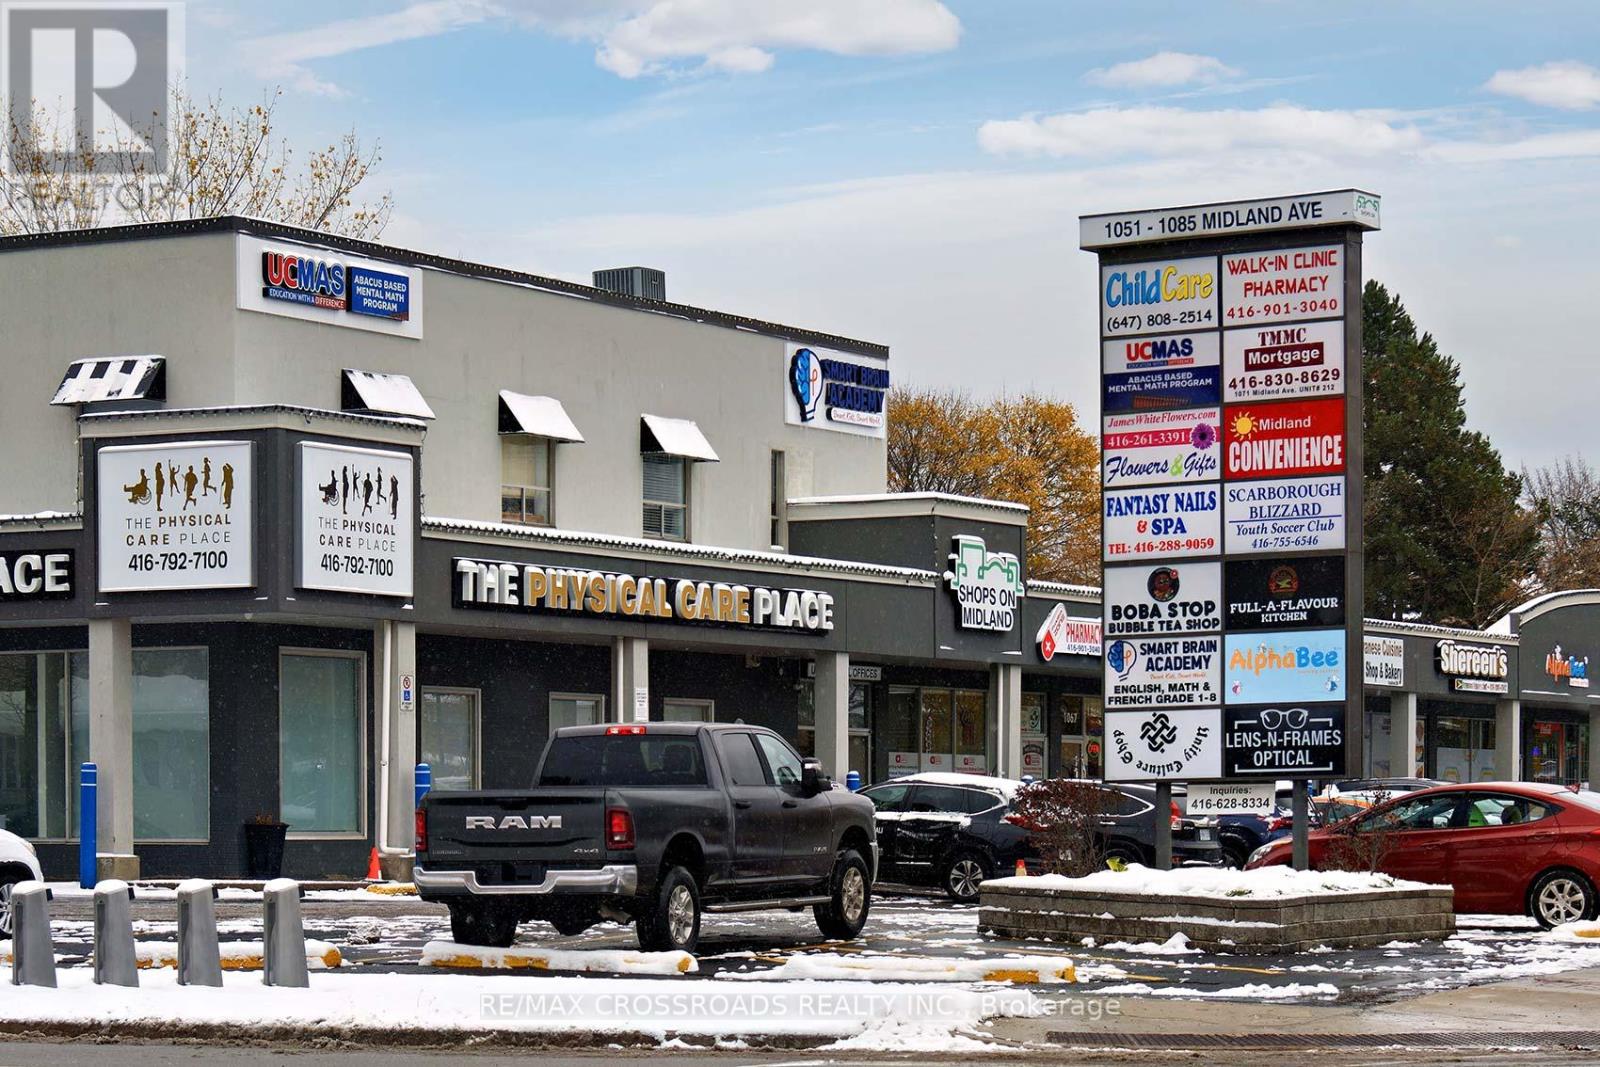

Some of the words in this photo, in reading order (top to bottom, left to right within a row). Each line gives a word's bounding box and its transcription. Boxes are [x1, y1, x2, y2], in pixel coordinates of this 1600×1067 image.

[1104, 221, 1141, 238] 1051
[1159, 215, 1196, 234] 1085
[1202, 206, 1282, 230] MIDLAND
[1288, 201, 1322, 221] AVE
[1227, 254, 1288, 275] WALK-IN
[1294, 250, 1337, 269] CLINIC
[265, 251, 345, 296] UCMAS
[354, 275, 382, 288] ABACUS
[384, 280, 407, 292] BASED
[1106, 265, 1213, 308] ChildCare
[1244, 275, 1328, 298] PHARMACY
[356, 286, 384, 298] MENTAL
[385, 290, 405, 302] MATH
[363, 298, 398, 312] PROGRAM
[1227, 299, 1338, 319] 416-901-3040
[1107, 315, 1142, 332] (647)
[1147, 310, 1212, 327] 808-2514
[1258, 328, 1306, 346] TMMC
[1126, 338, 1193, 361] UCMAS
[1249, 349, 1320, 365] Mortgage
[822, 360, 859, 383] SMART
[860, 366, 889, 388] BRAIN
[1128, 374, 1162, 384] ABACUS
[1164, 372, 1193, 381] BASED
[1229, 368, 1340, 390] 416-830-8629
[1108, 383, 1142, 393] MENTAL
[1145, 380, 1168, 390] MATH
[1170, 378, 1212, 388] PROGRAM
[1252, 388, 1279, 396] Midland
[827, 383, 884, 413] ACADEMY
[1108, 411, 1216, 428] JamesWhiteFlowers.com
[1259, 416, 1311, 431] Midland
[1108, 431, 1185, 447] 416-261-3391
[1229, 435, 1342, 472] CONVENIENCE
[1106, 456, 1169, 483] Flowers
[1170, 455, 1183, 477] &
[1184, 452, 1217, 477] Gifts
[1228, 483, 1341, 502] SCARBOROUGH
[1106, 493, 1170, 517] FANTASY
[1174, 491, 1216, 513] NAILS
[1249, 503, 1322, 519] BLIZZARD
[126, 517, 152, 530] THE
[158, 514, 232, 527] PHYSICAL
[318, 516, 338, 530] THE
[342, 520, 396, 536] PHYSICAL
[1137, 520, 1147, 533] &
[1151, 518, 1187, 535] SPA
[1236, 523, 1267, 536] Youth
[1271, 521, 1304, 534] Soccer
[1307, 519, 1335, 531] Club
[126, 533, 170, 546] CARE
[179, 531, 231, 544] PLACE
[319, 534, 352, 548] CARE
[358, 538, 396, 552] PLACE
[1108, 543, 1131, 554] TEL:
[1134, 538, 1214, 553] 416-288-9059
[1252, 536, 1318, 549] 416-755-6546
[128, 550, 228, 572] 416-792-7100
[320, 552, 394, 577] 416-792-7100
[457, 559, 519, 605] THE
[524, 566, 672, 618] PHYSICAL
[676, 579, 750, 624] CARE
[753, 587, 834, 631] PLACE
[959, 585, 996, 605] SHOPS
[999, 588, 1016, 608] ON
[1111, 603, 1162, 620] BOBA
[1167, 600, 1216, 618] STOP
[1230, 597, 1338, 614] FULL-A-FLAVOUR
[963, 607, 1013, 629] MIDLAND
[1108, 620, 1154, 634] BUBBLE
[1158, 620, 1182, 631] TEA
[1186, 618, 1220, 630] SHOP
[1261, 612, 1307, 623] KITCHEN
[1066, 623, 1102, 645] PHARMAC
[1140, 642, 1179, 655] SMART
[1182, 640, 1217, 654] BRAIN
[1146, 655, 1211, 672] ACADEMY
[1229, 647, 1339, 676] AlphaBee
[1441, 641, 1508, 677] Shereen's
[852, 668, 878, 678] OFFICES
[1114, 683, 1164, 695] ENGLISH,
[1168, 683, 1199, 693] MATH
[1203, 682, 1210, 691] &
[1108, 695, 1153, 706] FRENCH
[1156, 694, 1194, 704] GRADE
[1198, 693, 1217, 703] 1-8
[1226, 730, 1341, 748] LENS-N-FRAMES
[1254, 749, 1313, 766] OPTICAL
[1210, 786, 1252, 796] Inquiries:
[1191, 797, 1270, 810] 416-628-8334
[465, 815, 562, 830] RAM
